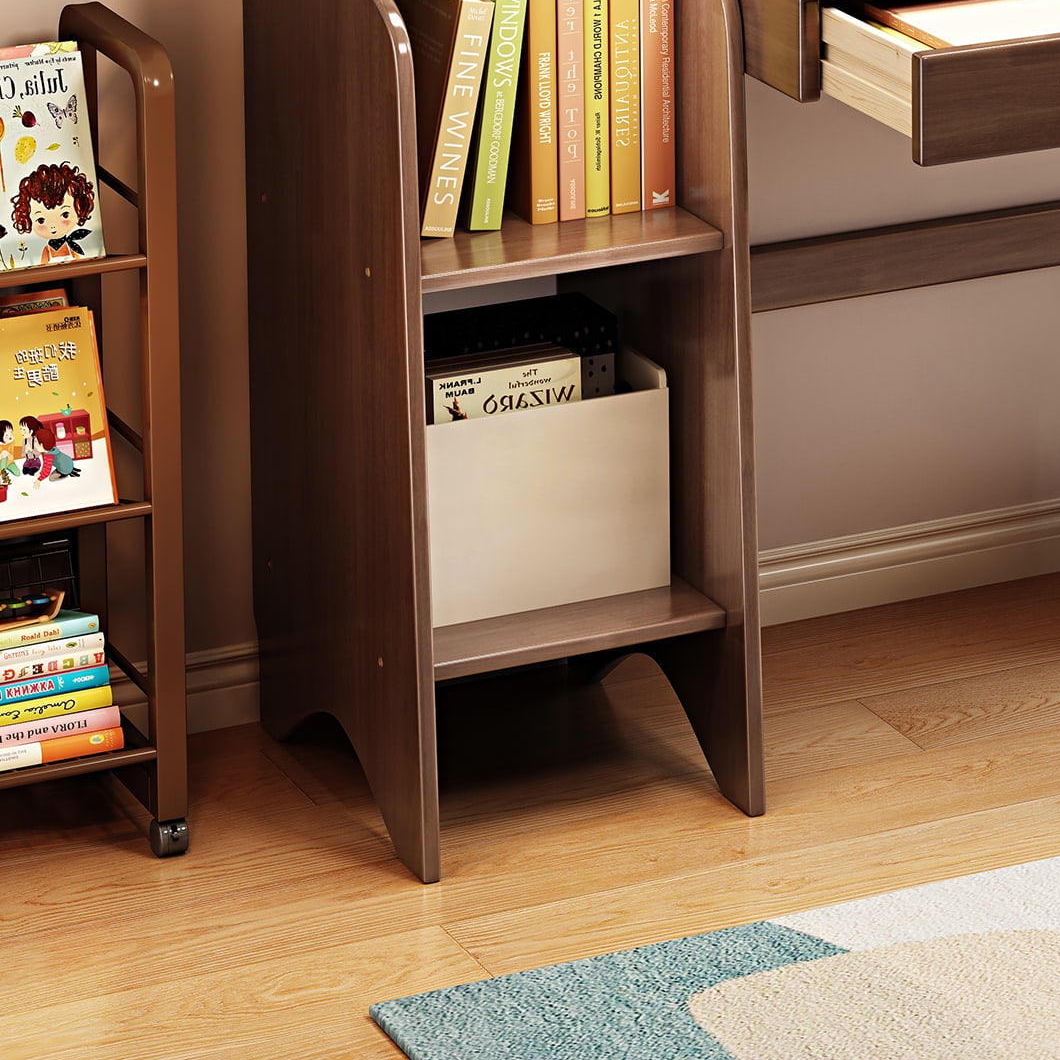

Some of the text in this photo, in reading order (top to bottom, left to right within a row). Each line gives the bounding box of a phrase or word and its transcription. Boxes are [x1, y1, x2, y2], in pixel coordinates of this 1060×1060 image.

[649, 3, 658, 33] McLeod
[660, 3, 671, 56] Contemporary
[538, 52, 551, 144] FRANK LLOYD WRIGHT
[662, 57, 671, 98] Residential
[433, 33, 483, 206] FINE WINES
[491, 98, 504, 140] BERGDORF
[662, 99, 671, 143] Architecture
[487, 141, 501, 185] GOODMAN
[21, 628, 60, 642] Roald Dahl
[2, 651, 104, 680] A B C D E F G
[6, 680, 55, 699] КНИЖКА
[6, 719, 88, 741] FLORA and the
